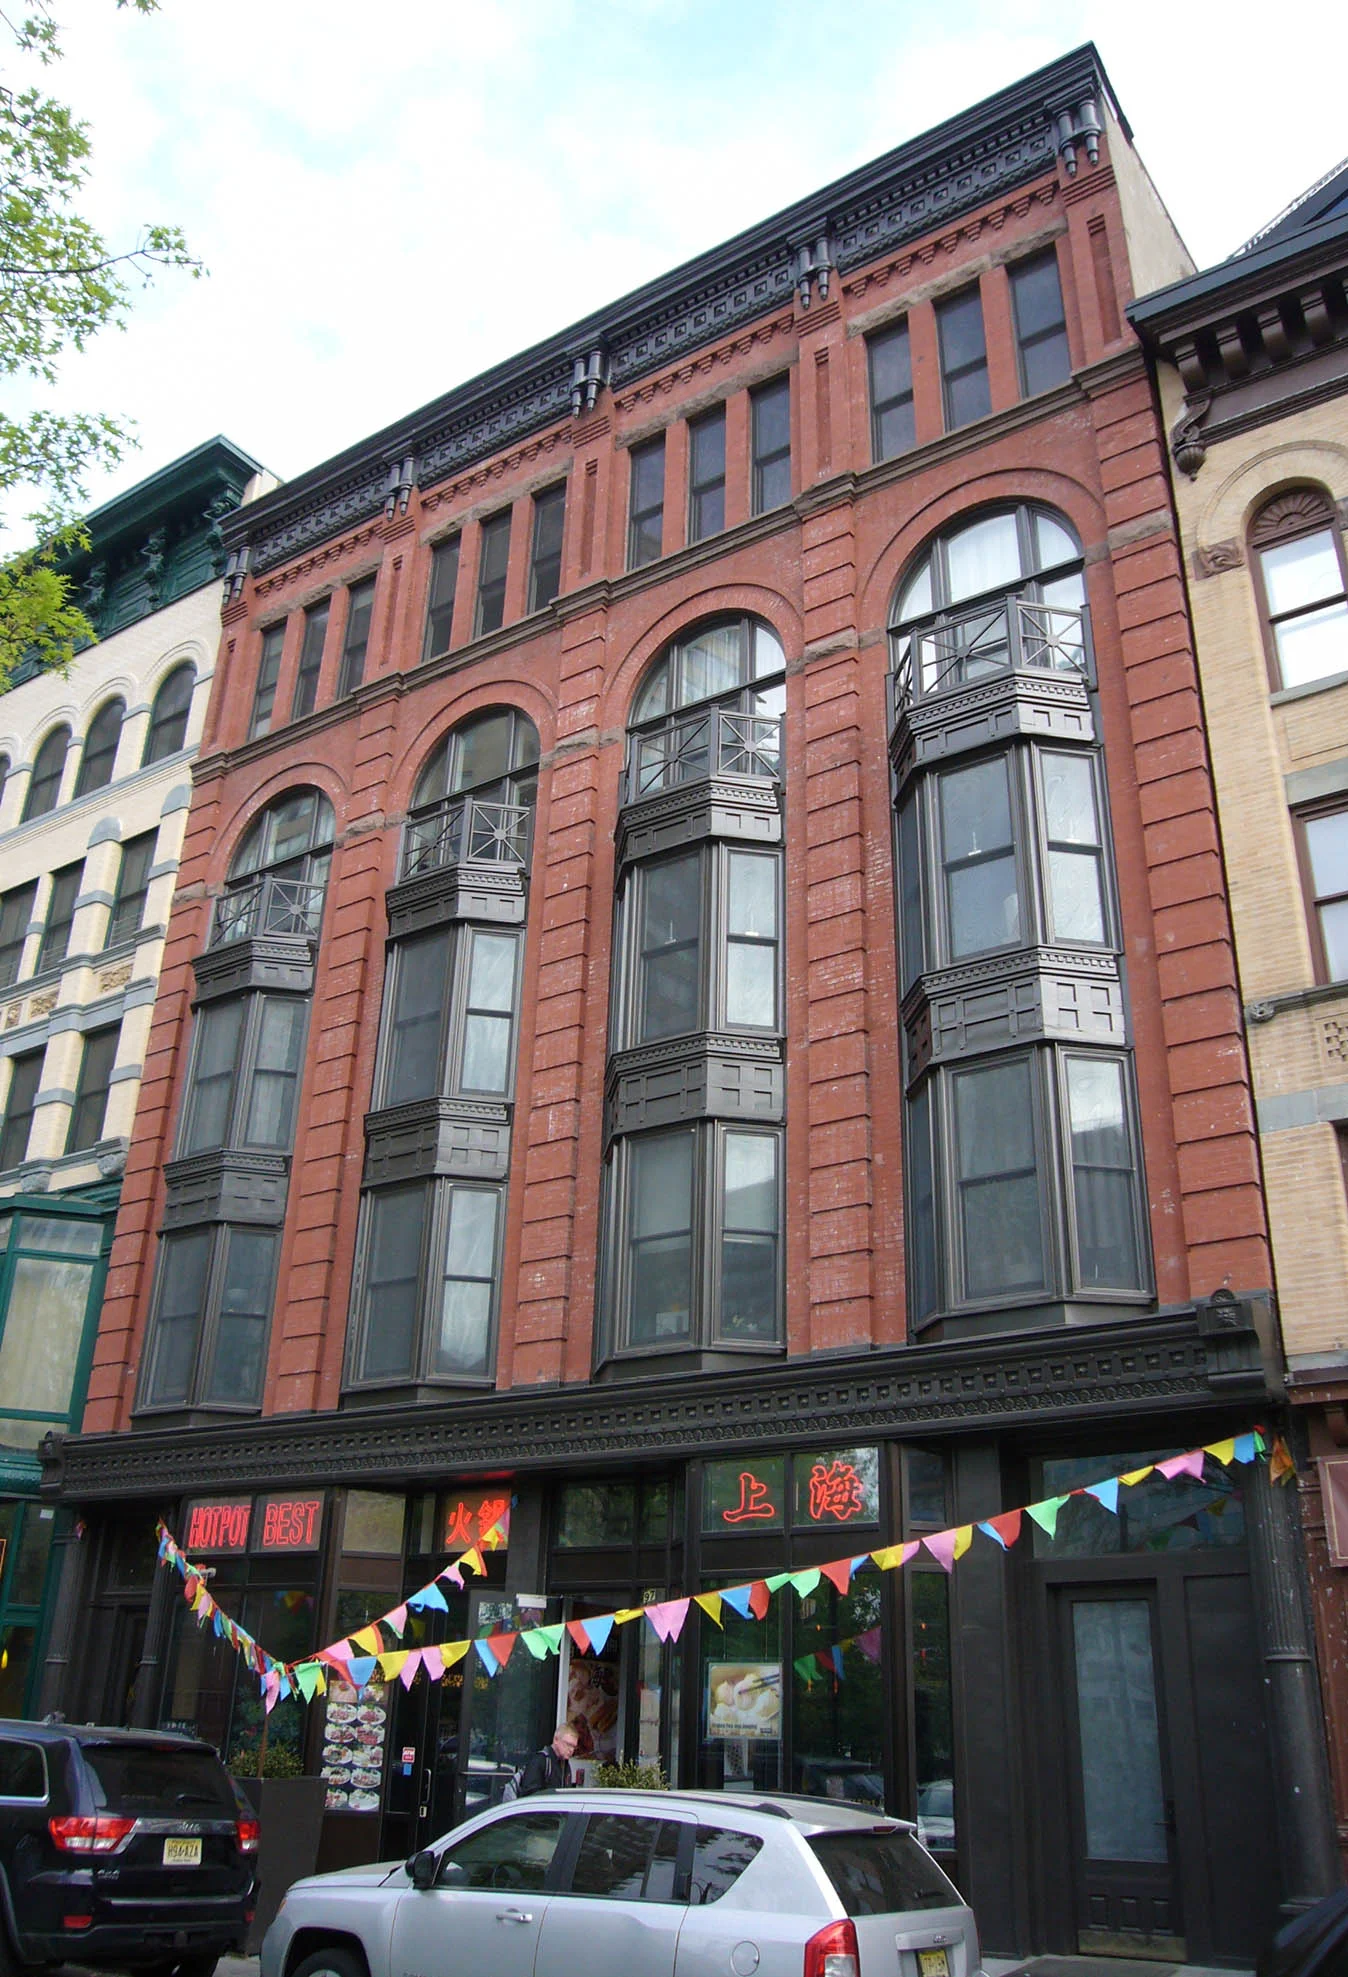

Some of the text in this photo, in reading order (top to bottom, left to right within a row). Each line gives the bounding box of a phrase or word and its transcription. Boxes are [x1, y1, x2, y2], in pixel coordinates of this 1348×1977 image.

[723, 1460, 863, 1521] 上海
[188, 1501, 320, 1548] HOTPOT BEST
[643, 1590, 656, 1605] 97
